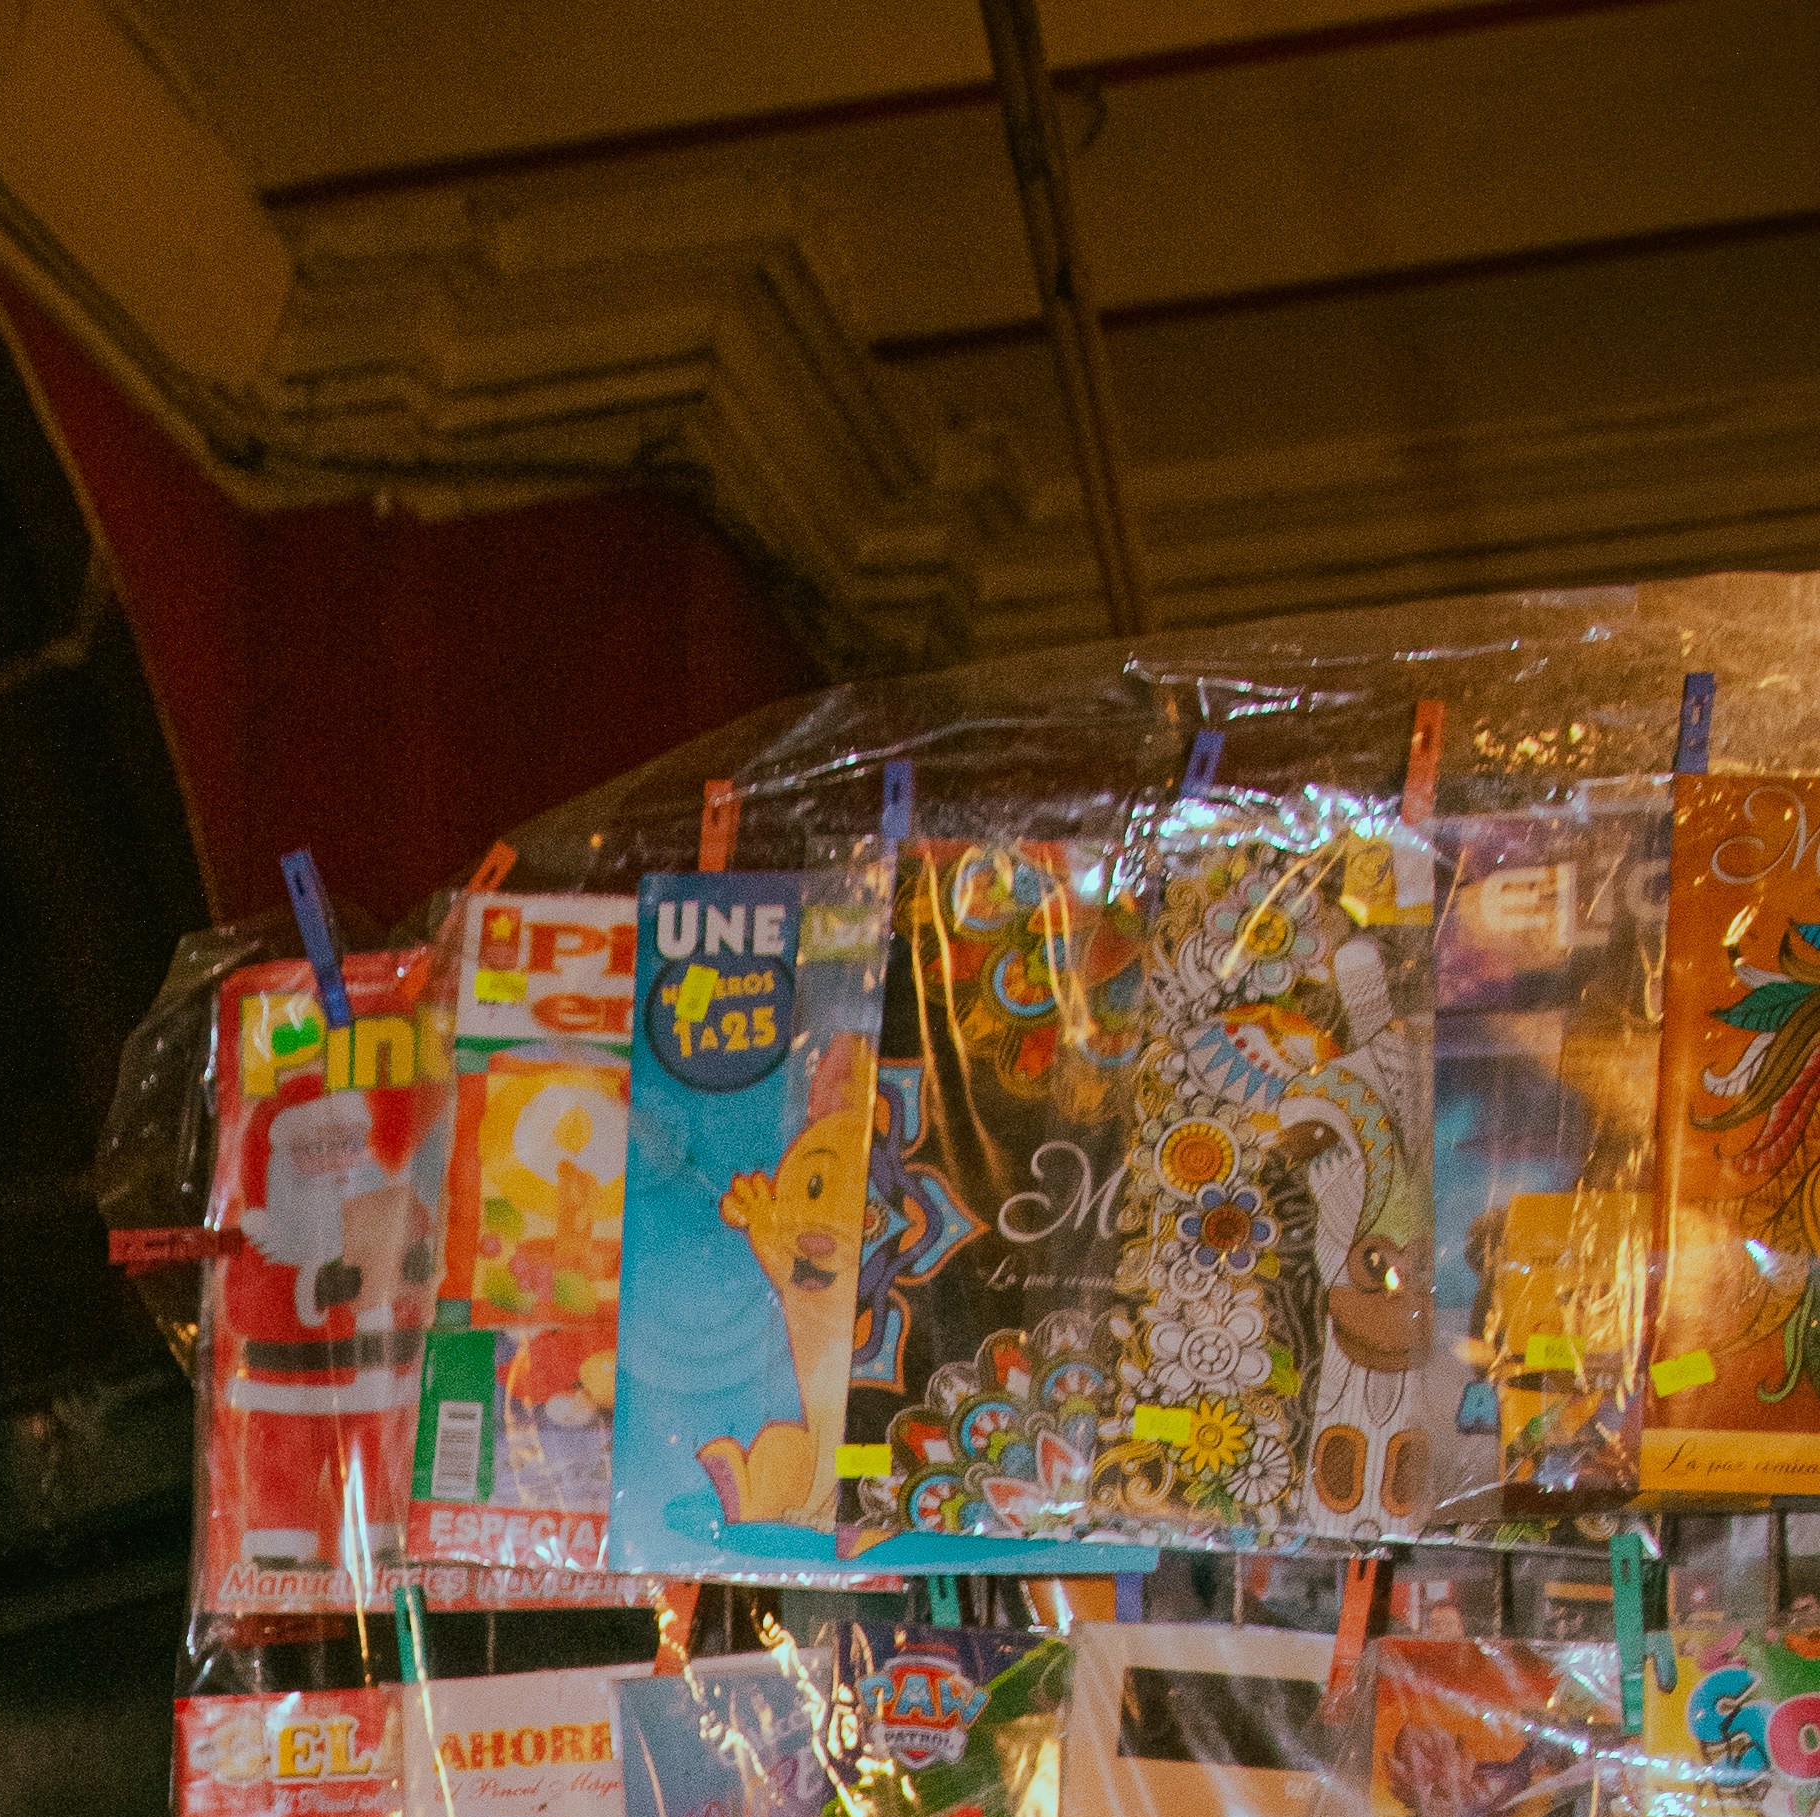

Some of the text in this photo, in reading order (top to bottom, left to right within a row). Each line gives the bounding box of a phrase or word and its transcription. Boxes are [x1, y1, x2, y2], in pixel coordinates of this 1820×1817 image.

[657, 904, 787, 958] UNE
[721, 1005, 777, 1053] 25
[858, 1673, 990, 1724] PAW
